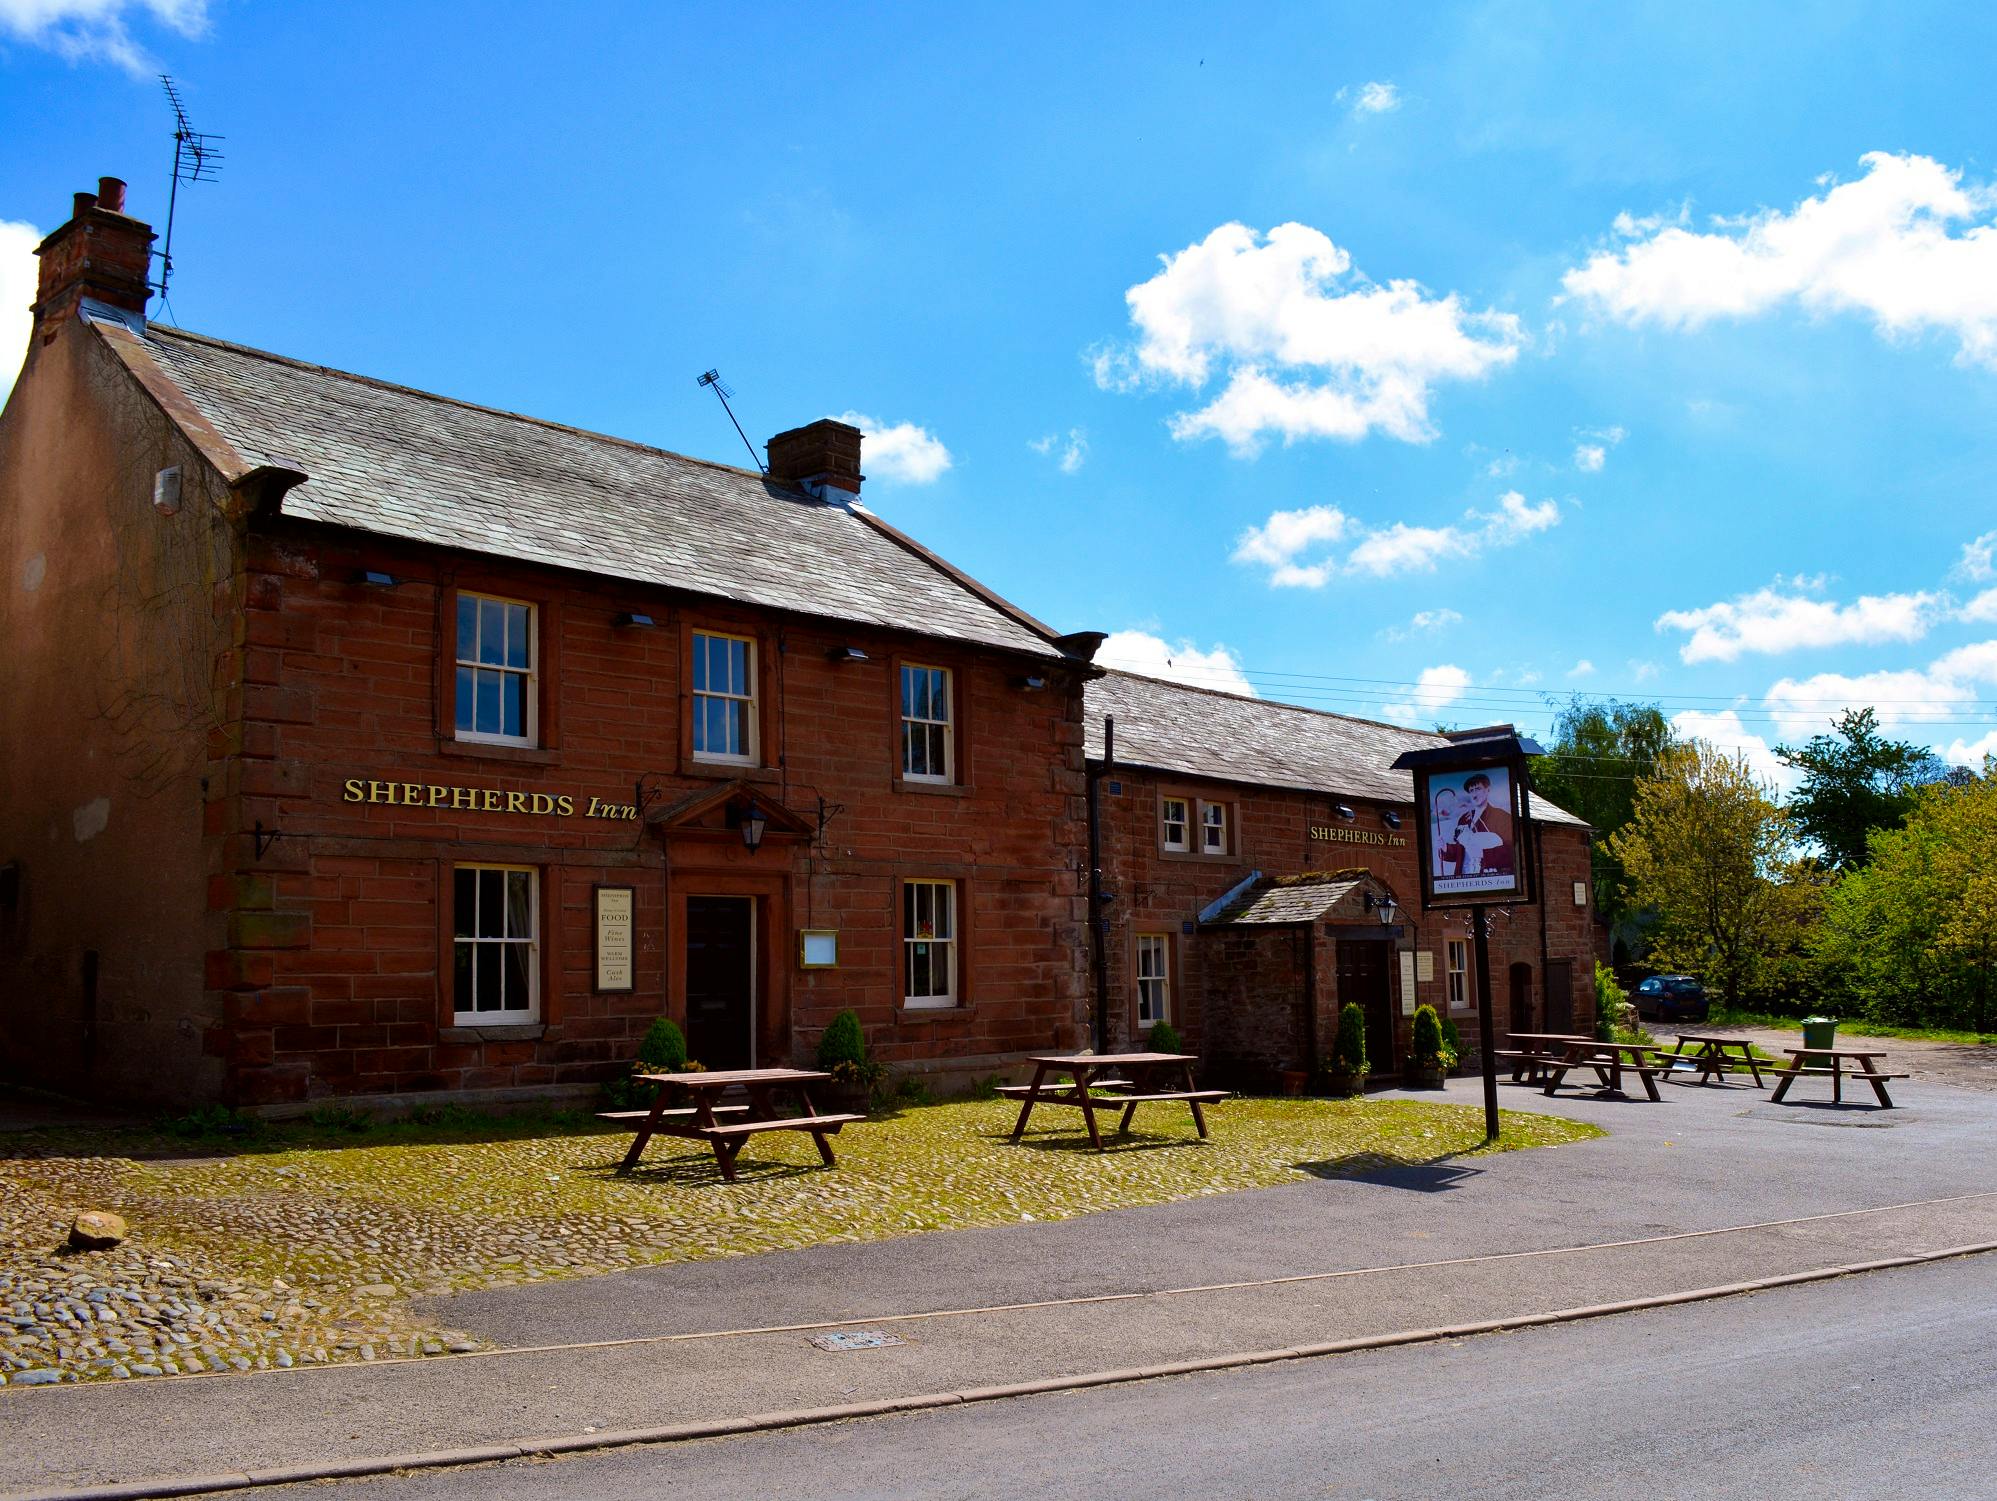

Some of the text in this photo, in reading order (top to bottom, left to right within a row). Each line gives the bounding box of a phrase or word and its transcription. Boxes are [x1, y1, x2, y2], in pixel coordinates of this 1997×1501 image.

[343, 779, 638, 820] SHEPHERDS Inn
[1310, 826, 1406, 847] SHEPHERDS Inn
[1438, 880, 1493, 889] SHEPHERDS
